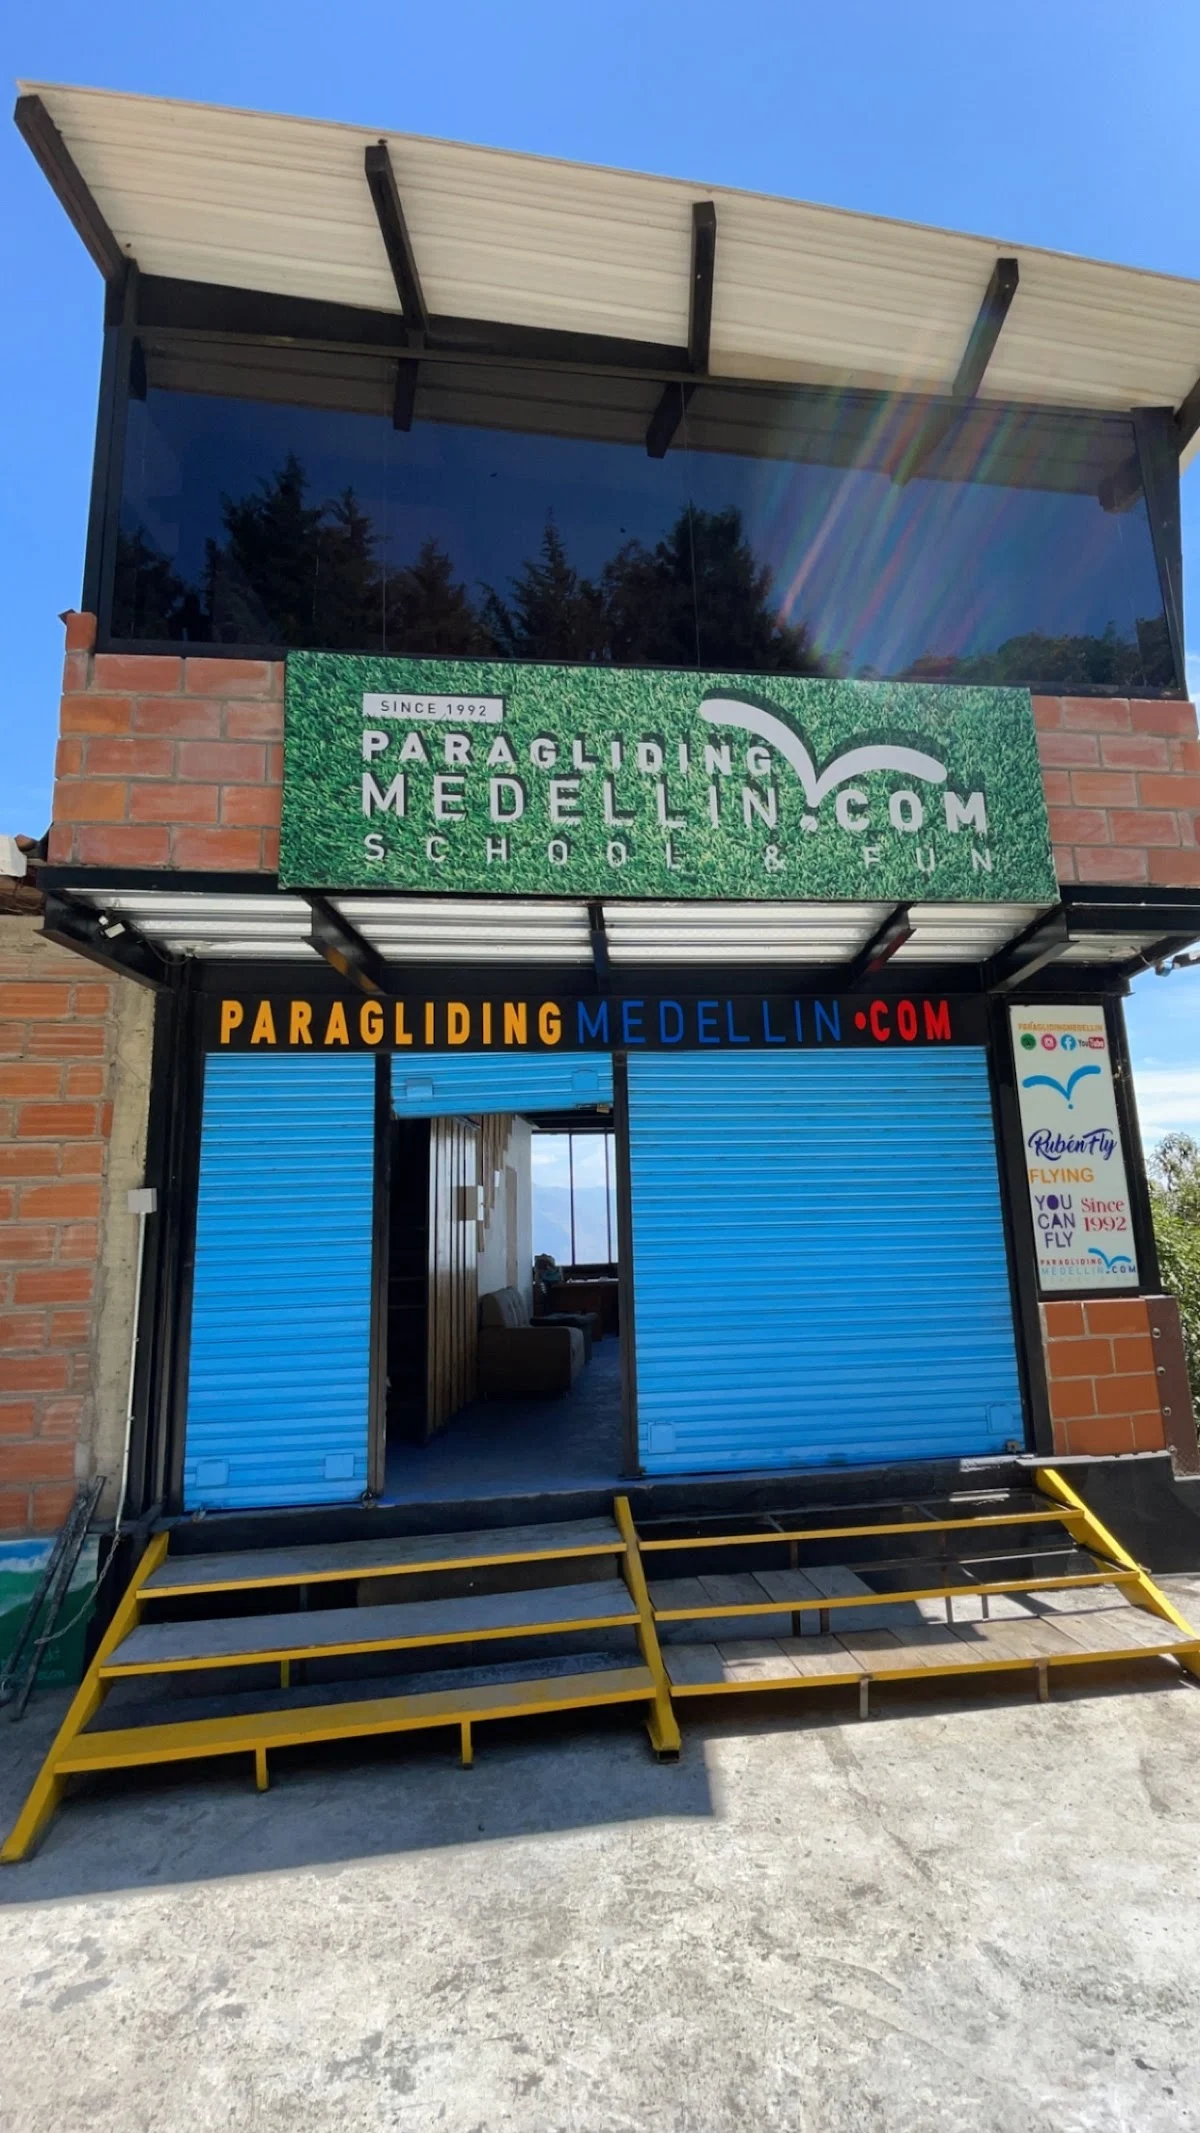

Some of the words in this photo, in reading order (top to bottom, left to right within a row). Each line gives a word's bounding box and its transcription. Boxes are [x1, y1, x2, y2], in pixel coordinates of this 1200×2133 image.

[380, 699, 437, 715] SINCE
[446, 703, 487, 717] 1992
[361, 729, 772, 777] PARAGLIDING
[362, 833, 680, 870] SCHOOL
[764, 844, 786, 874] &
[864, 845, 993, 874] FUN
[1029, 1167, 1095, 1184] FLYING
[1034, 1194, 1072, 1211] YOU
[1081, 1197, 1125, 1213] Since
[1037, 1213, 1076, 1230] CAN
[1083, 1215, 1127, 1233] 1992
[1044, 1231, 1074, 1249] FLY
[1040, 1258, 1102, 1266] PARAGLIDING
